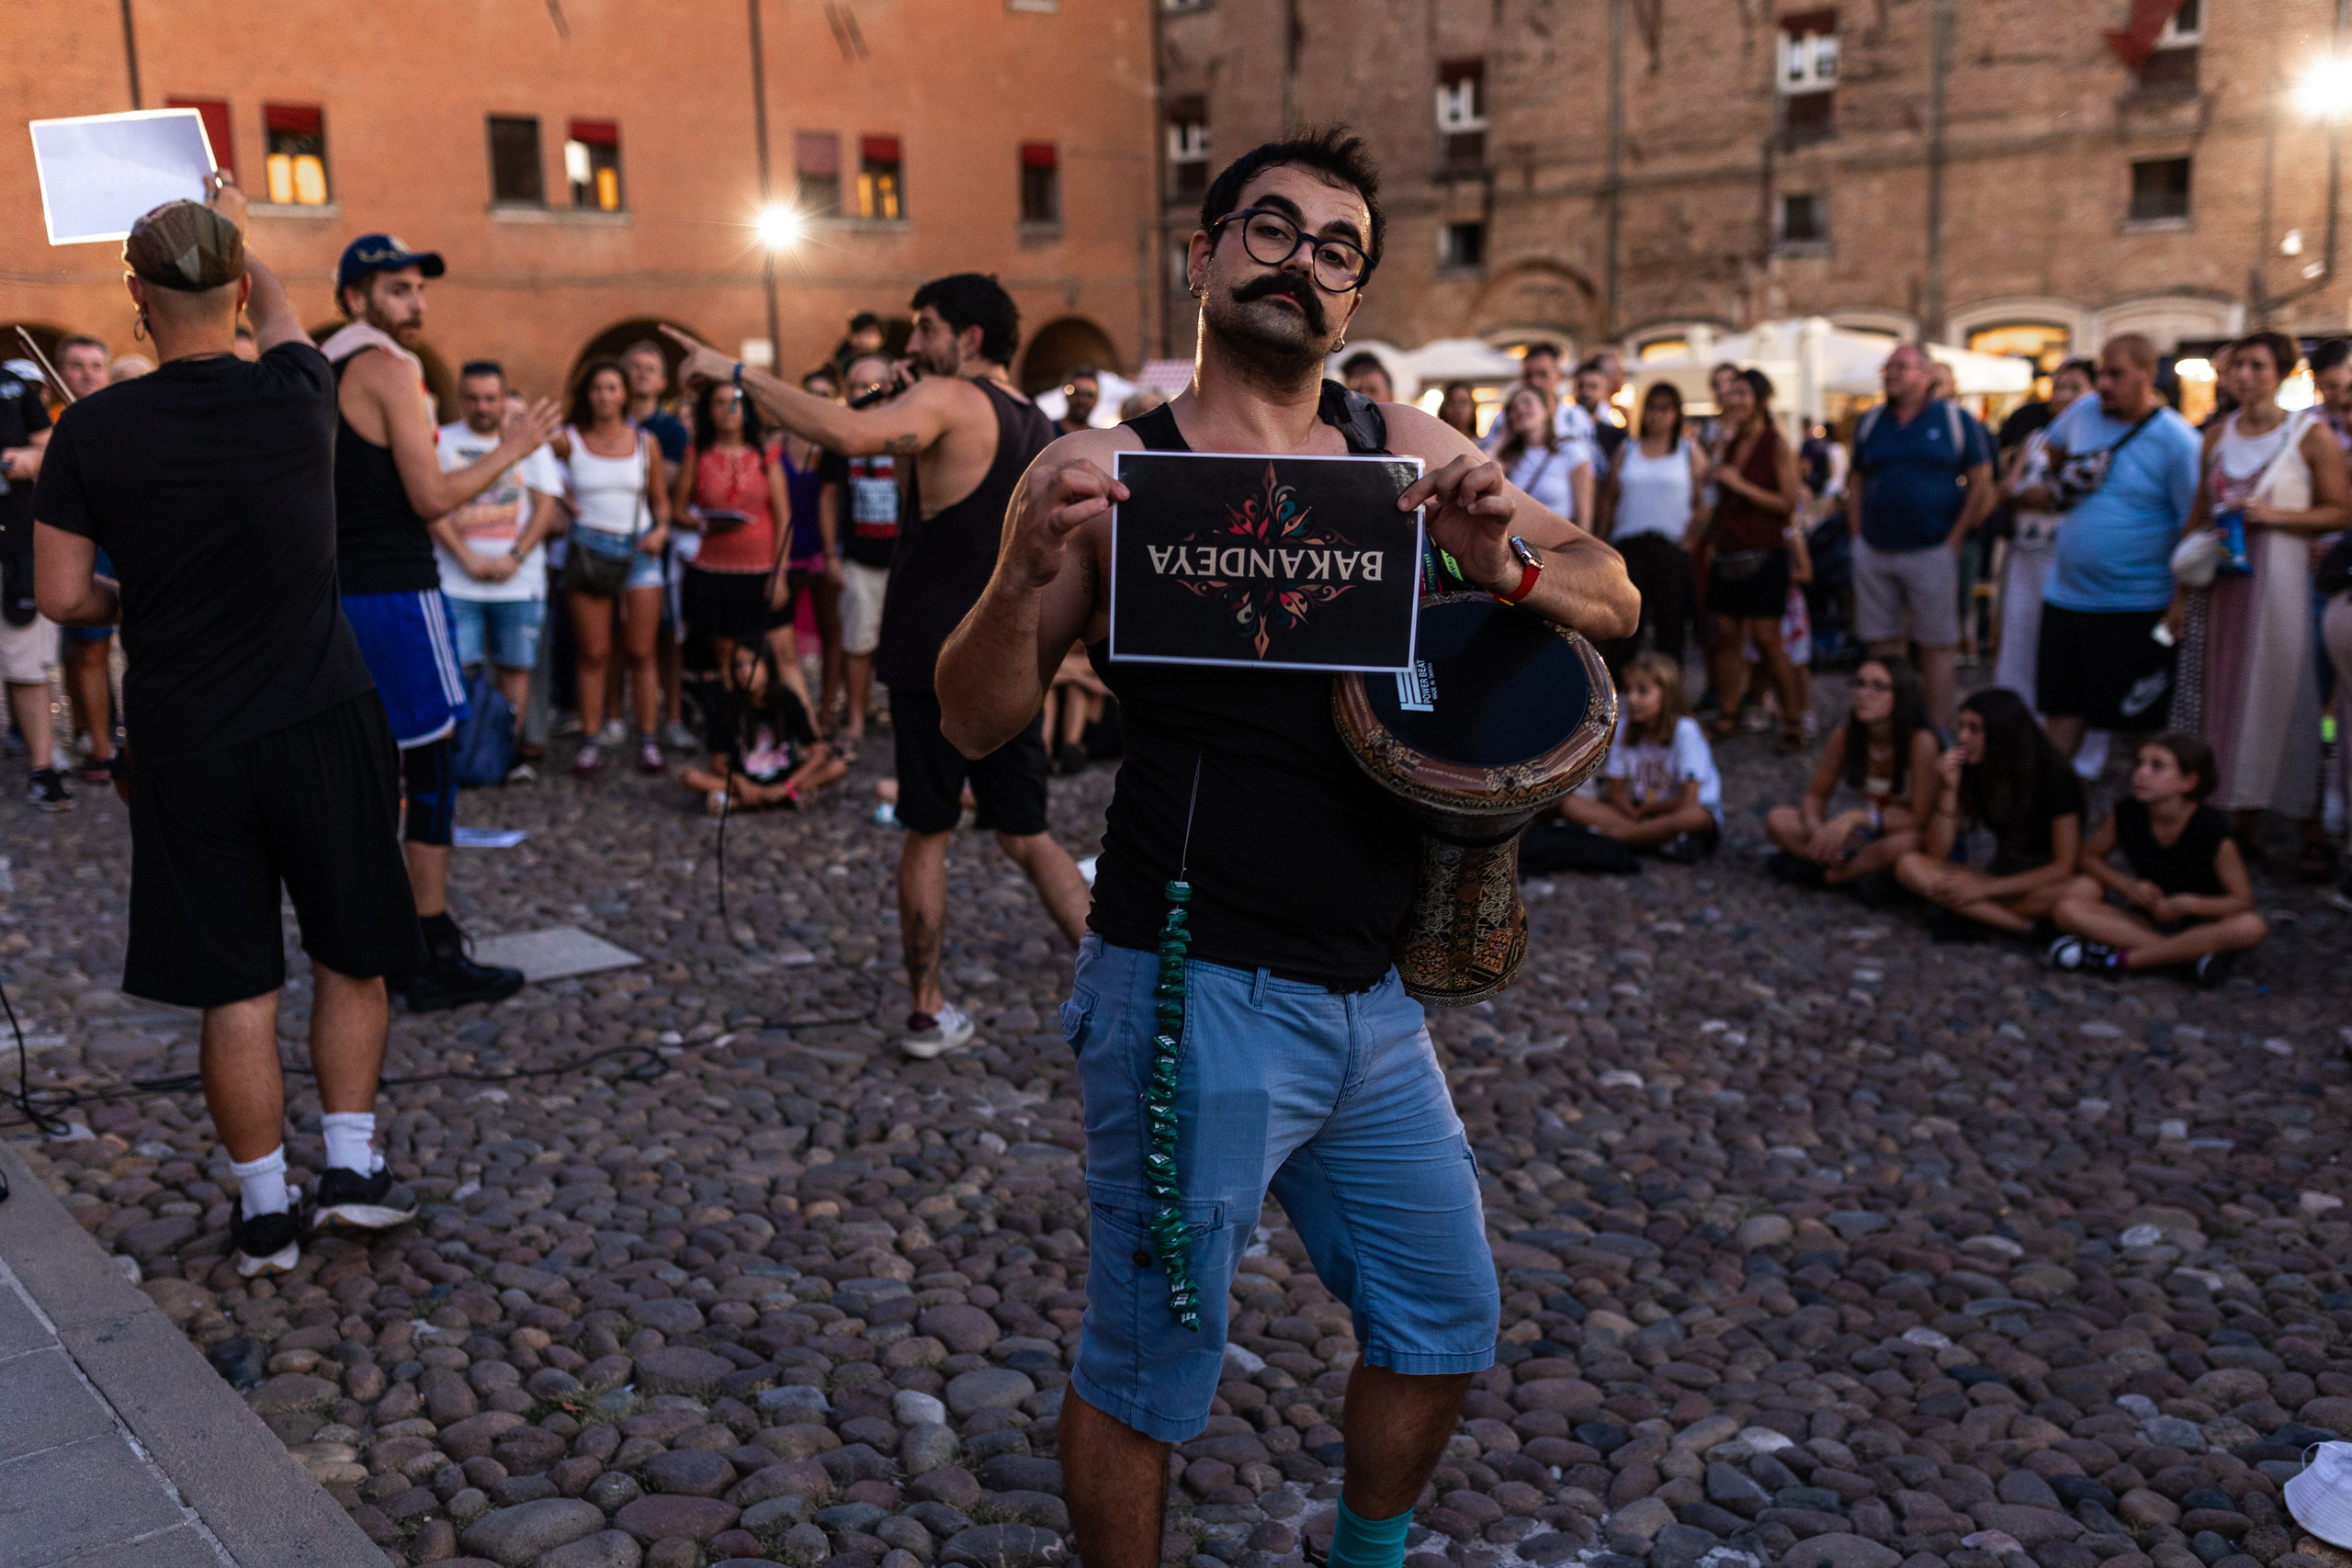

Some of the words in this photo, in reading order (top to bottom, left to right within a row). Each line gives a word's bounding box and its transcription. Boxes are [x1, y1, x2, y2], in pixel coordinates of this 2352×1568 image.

[1147, 545, 1384, 581] BAKANDEYA
[1417, 659, 1428, 677] BEAT
[1419, 678, 1432, 704] POWER
